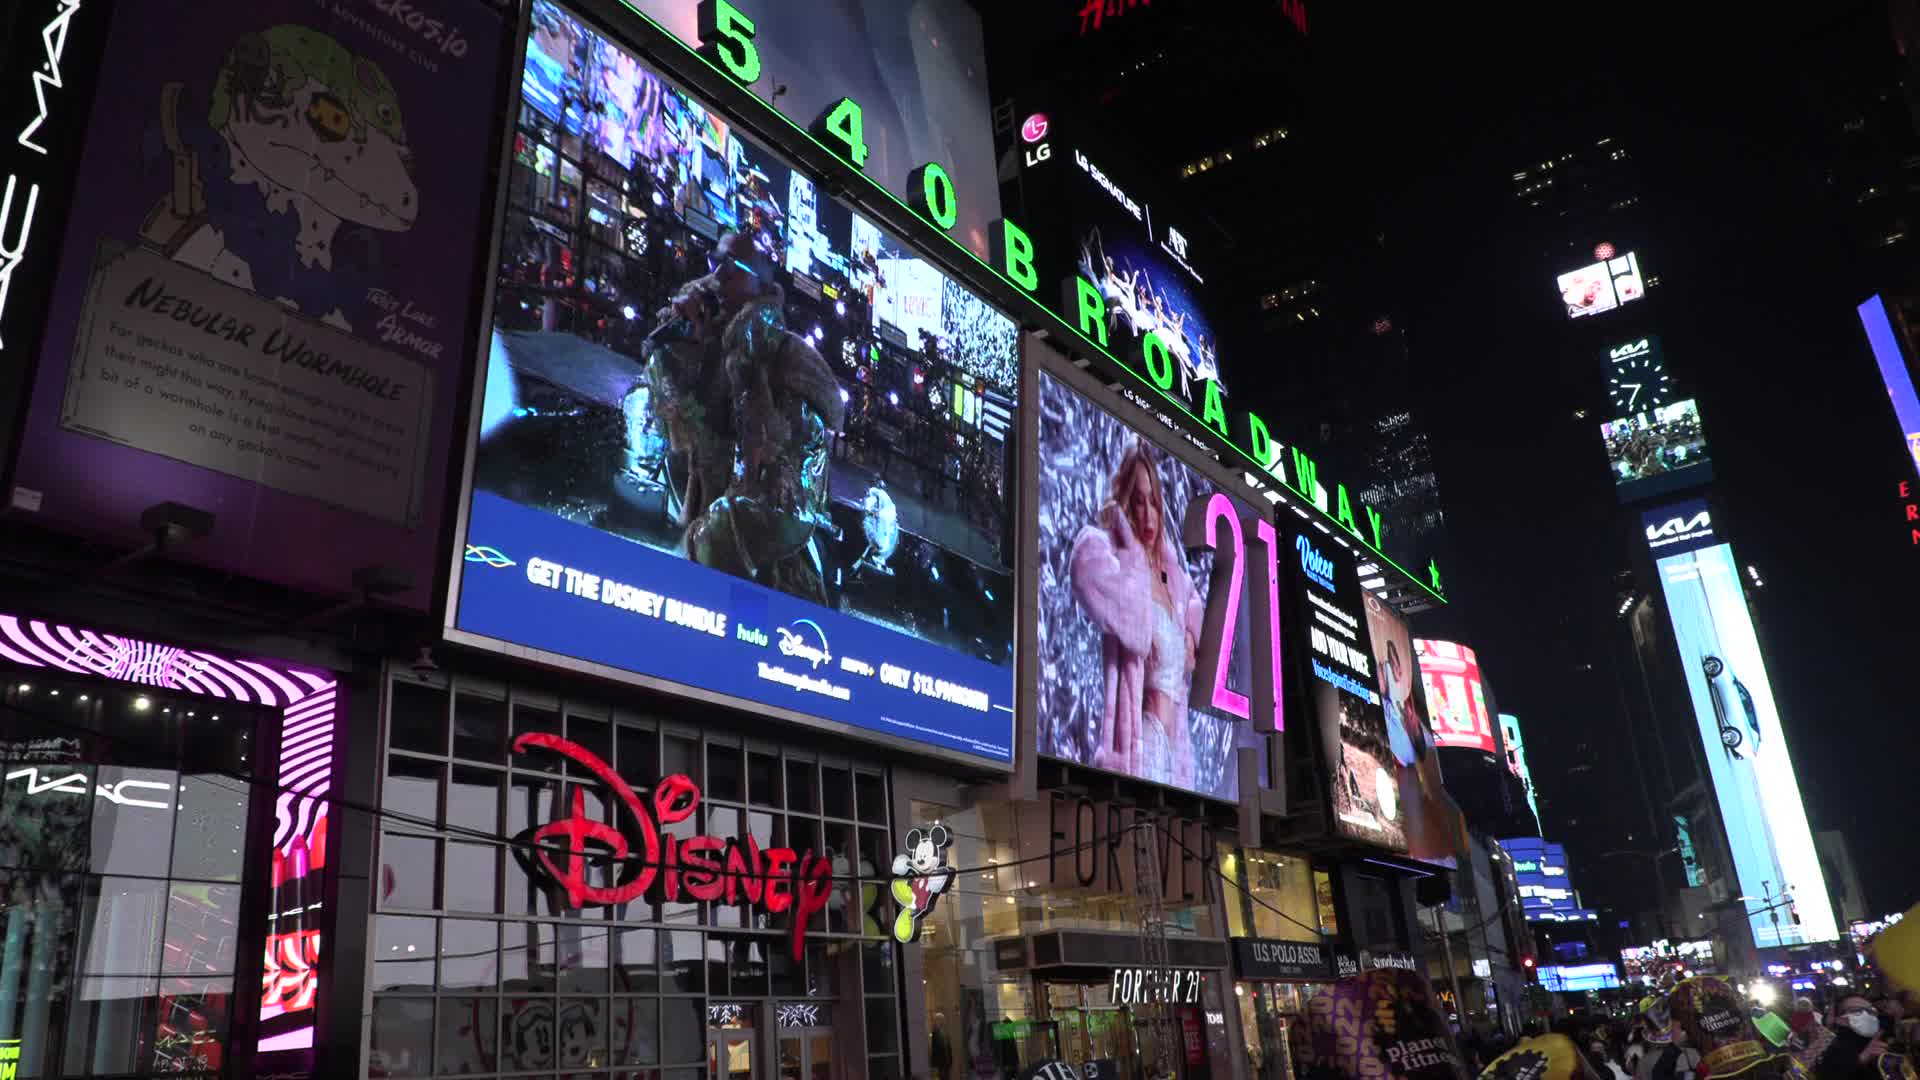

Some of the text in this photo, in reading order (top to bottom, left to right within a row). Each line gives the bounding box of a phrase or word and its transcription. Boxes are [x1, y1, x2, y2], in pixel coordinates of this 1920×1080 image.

[1025, 143, 1051, 167] LG
[1090, 163, 1143, 221] SIGNATURE
[124, 276, 408, 401] NEBULAR WORMHOLE
[1004, 218, 1381, 550] BROADWAY
[1296, 534, 1334, 581] Voices
[526, 556, 728, 638] GET THE DISNEY BUNDLE
[1206, 493, 1284, 732] 21
[736, 623, 769, 648] hulu
[879, 662, 911, 690] ONLY
[1326, 633, 1350, 667] YOUR
[1347, 645, 1371, 678] VOICE
[1270, 944, 1297, 964] POLO
[1185, 970, 1200, 1005] 21
